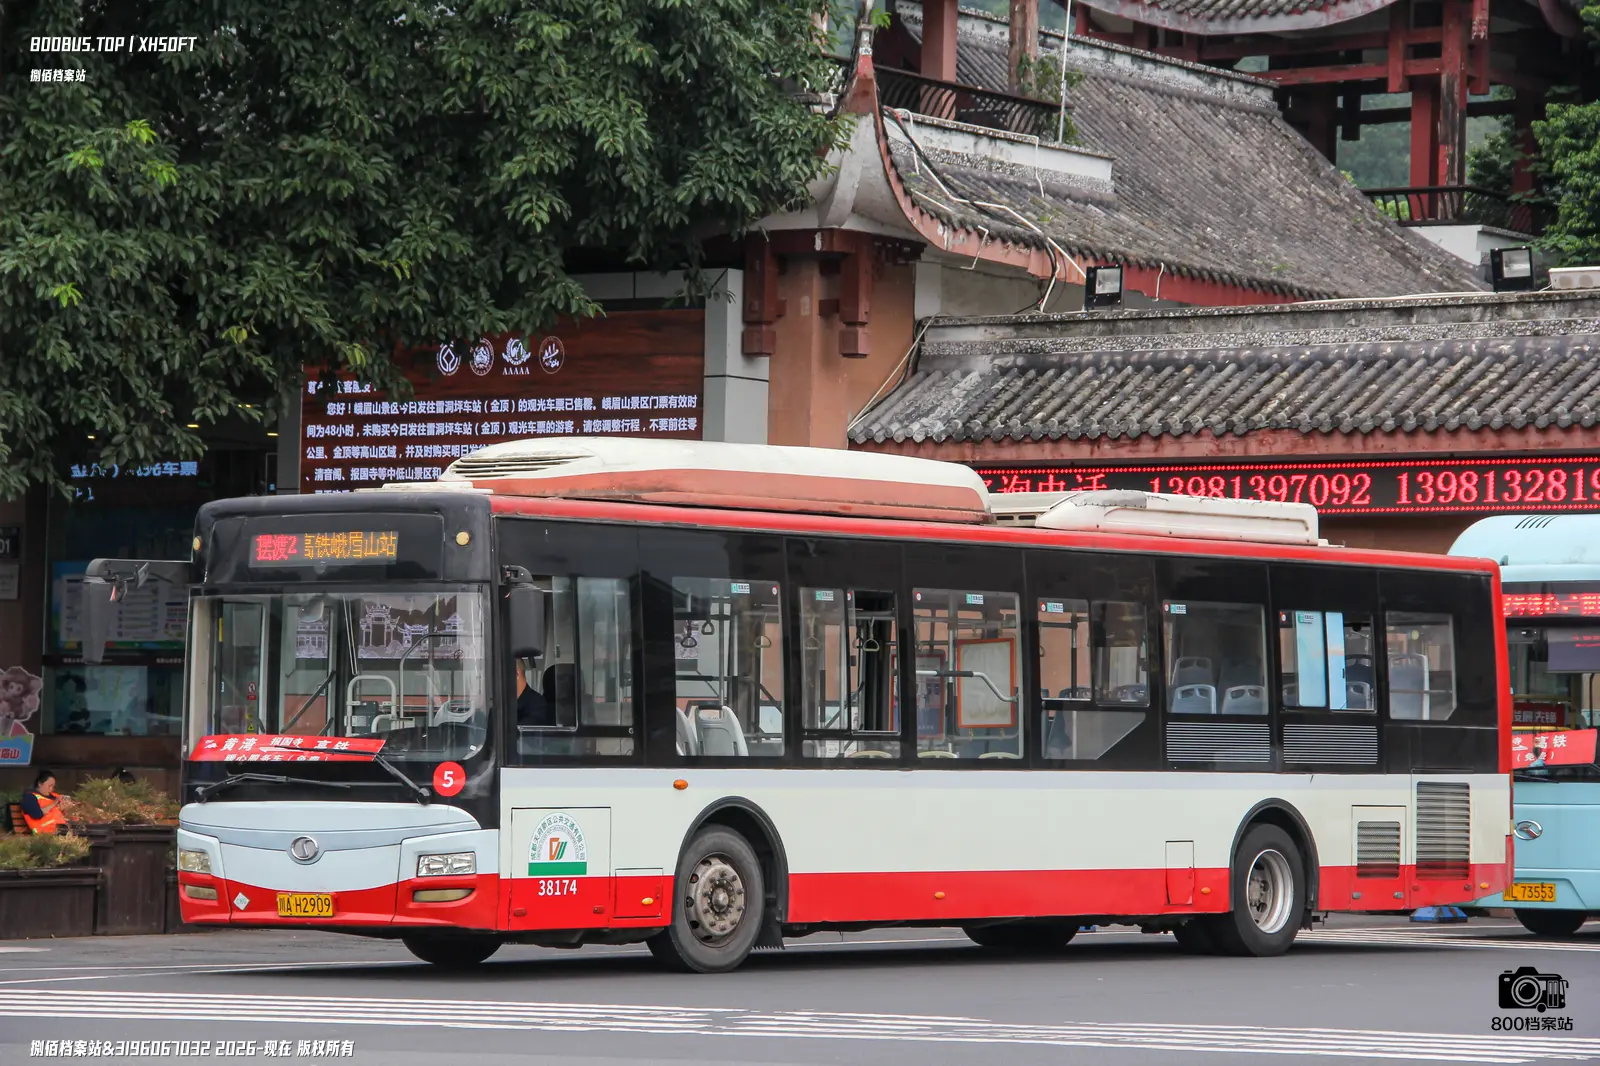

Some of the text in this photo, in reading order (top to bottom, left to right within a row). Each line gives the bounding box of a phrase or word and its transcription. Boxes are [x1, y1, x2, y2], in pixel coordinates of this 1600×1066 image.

[502, 366, 530, 376] AAAAA
[220, 737, 257, 752] 黄湾
[441, 770, 455, 789] 5
[537, 879, 578, 897] 38174
